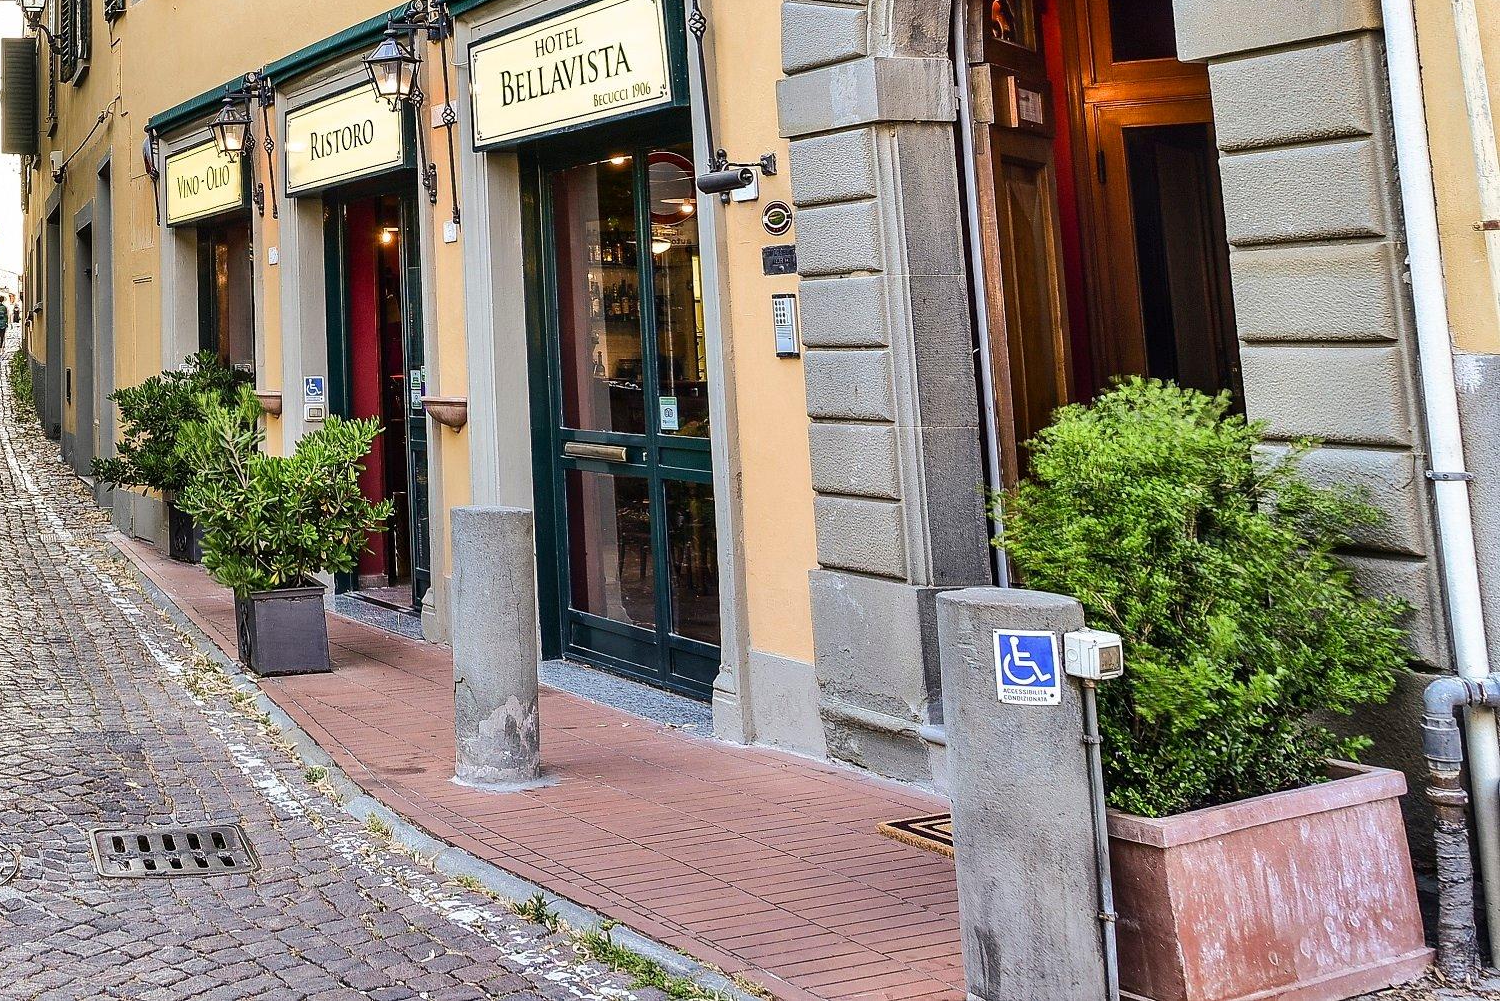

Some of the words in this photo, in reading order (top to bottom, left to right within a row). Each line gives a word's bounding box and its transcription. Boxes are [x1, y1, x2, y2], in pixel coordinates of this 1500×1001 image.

[534, 27, 583, 58] HOTEL
[500, 42, 632, 107] BELLAVISTA
[593, 89, 629, 107] BECUCCI
[632, 81, 652, 98] 1906
[310, 119, 374, 161] RISTORO
[177, 174, 200, 199] VINO
[206, 164, 230, 193] OLIO
